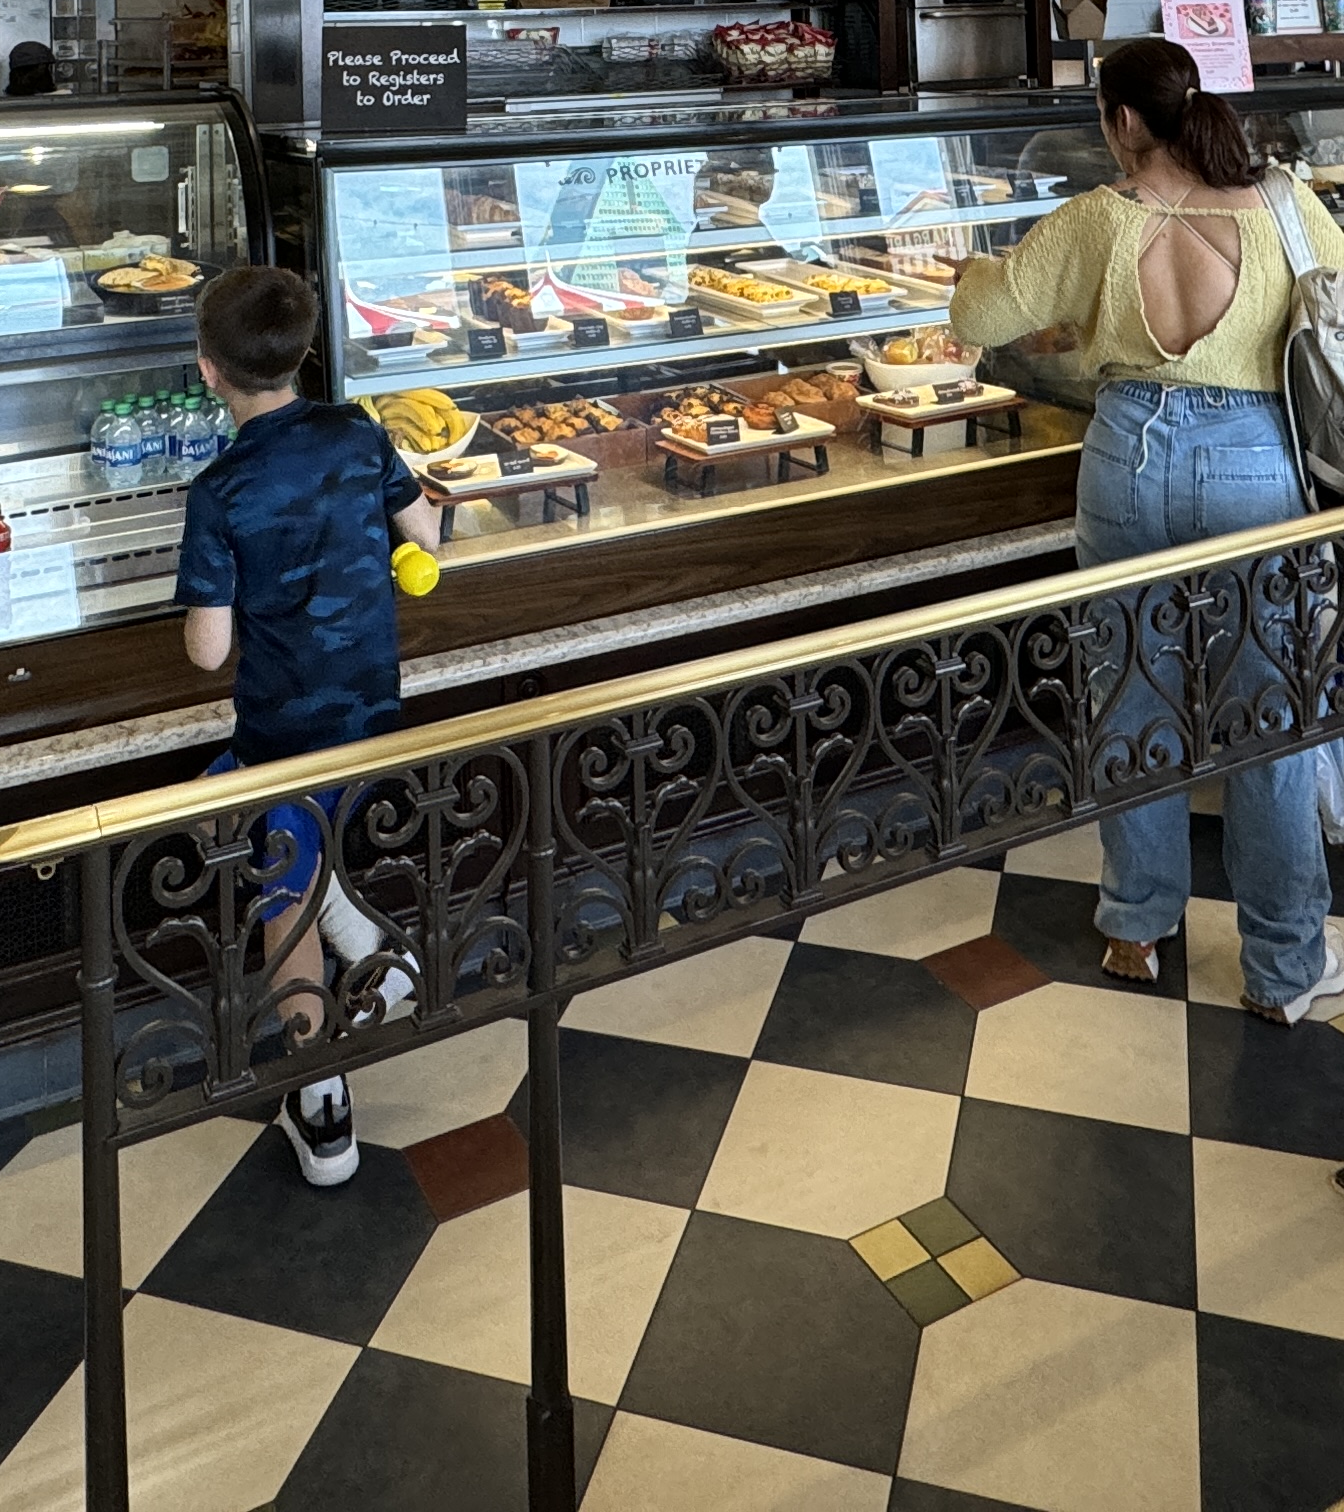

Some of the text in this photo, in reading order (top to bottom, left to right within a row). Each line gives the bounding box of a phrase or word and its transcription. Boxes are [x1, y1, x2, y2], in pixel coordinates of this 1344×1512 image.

[327, 48, 461, 66] Please Proceed
[342, 69, 445, 91] to Registers
[356, 89, 431, 106] to Order
